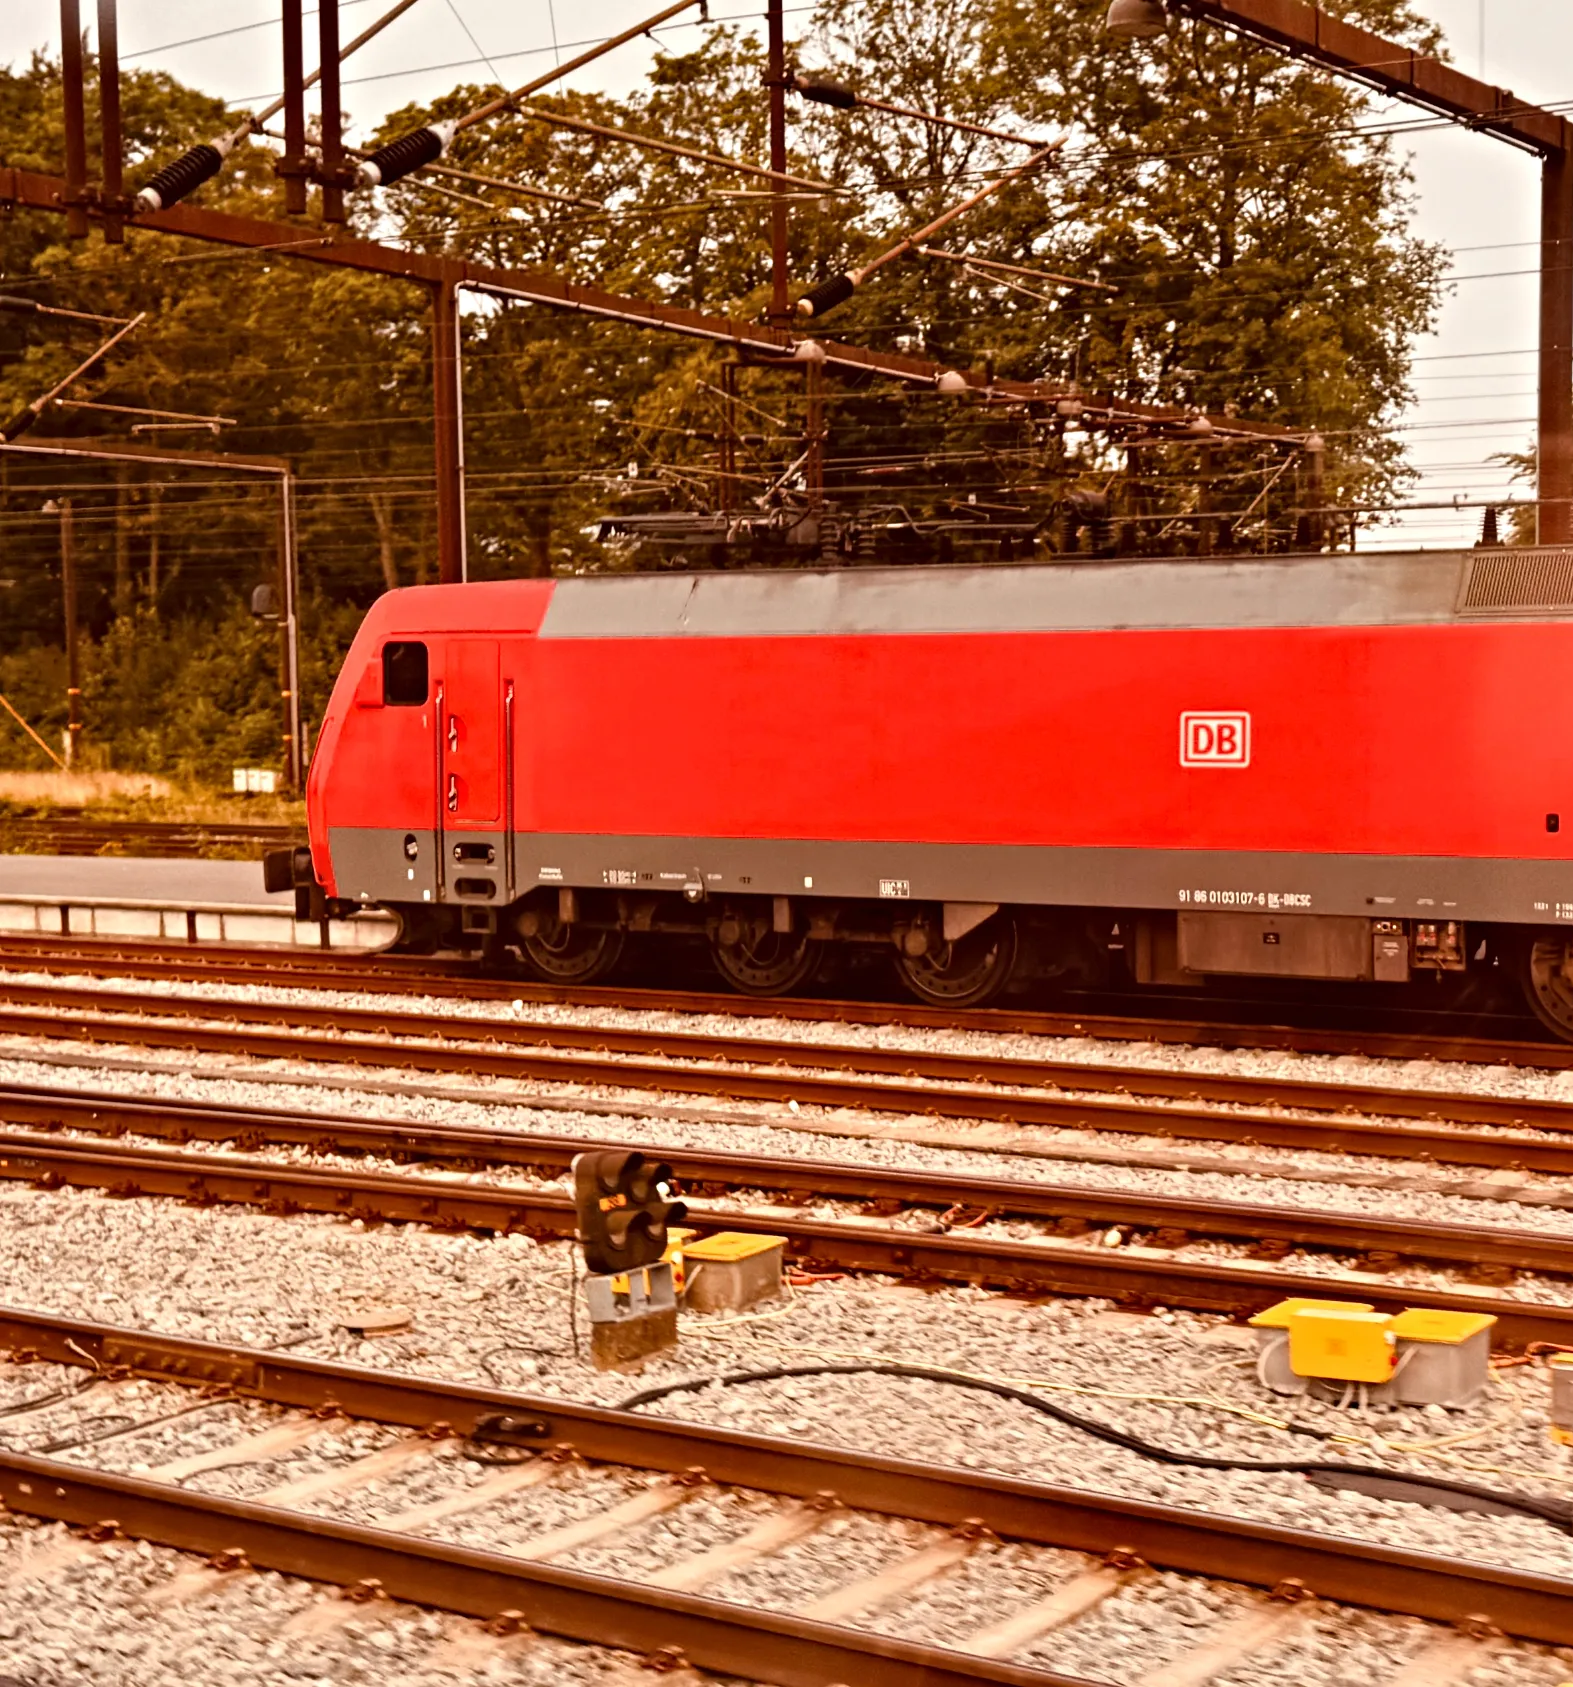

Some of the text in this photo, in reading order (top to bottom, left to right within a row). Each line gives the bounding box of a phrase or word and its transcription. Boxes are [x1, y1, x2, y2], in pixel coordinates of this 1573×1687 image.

[1192, 723, 1238, 756] DB
[1178, 889, 1191, 903] 91
[1193, 889, 1208, 903] 86
[1209, 890, 1266, 906] 0103107-6
